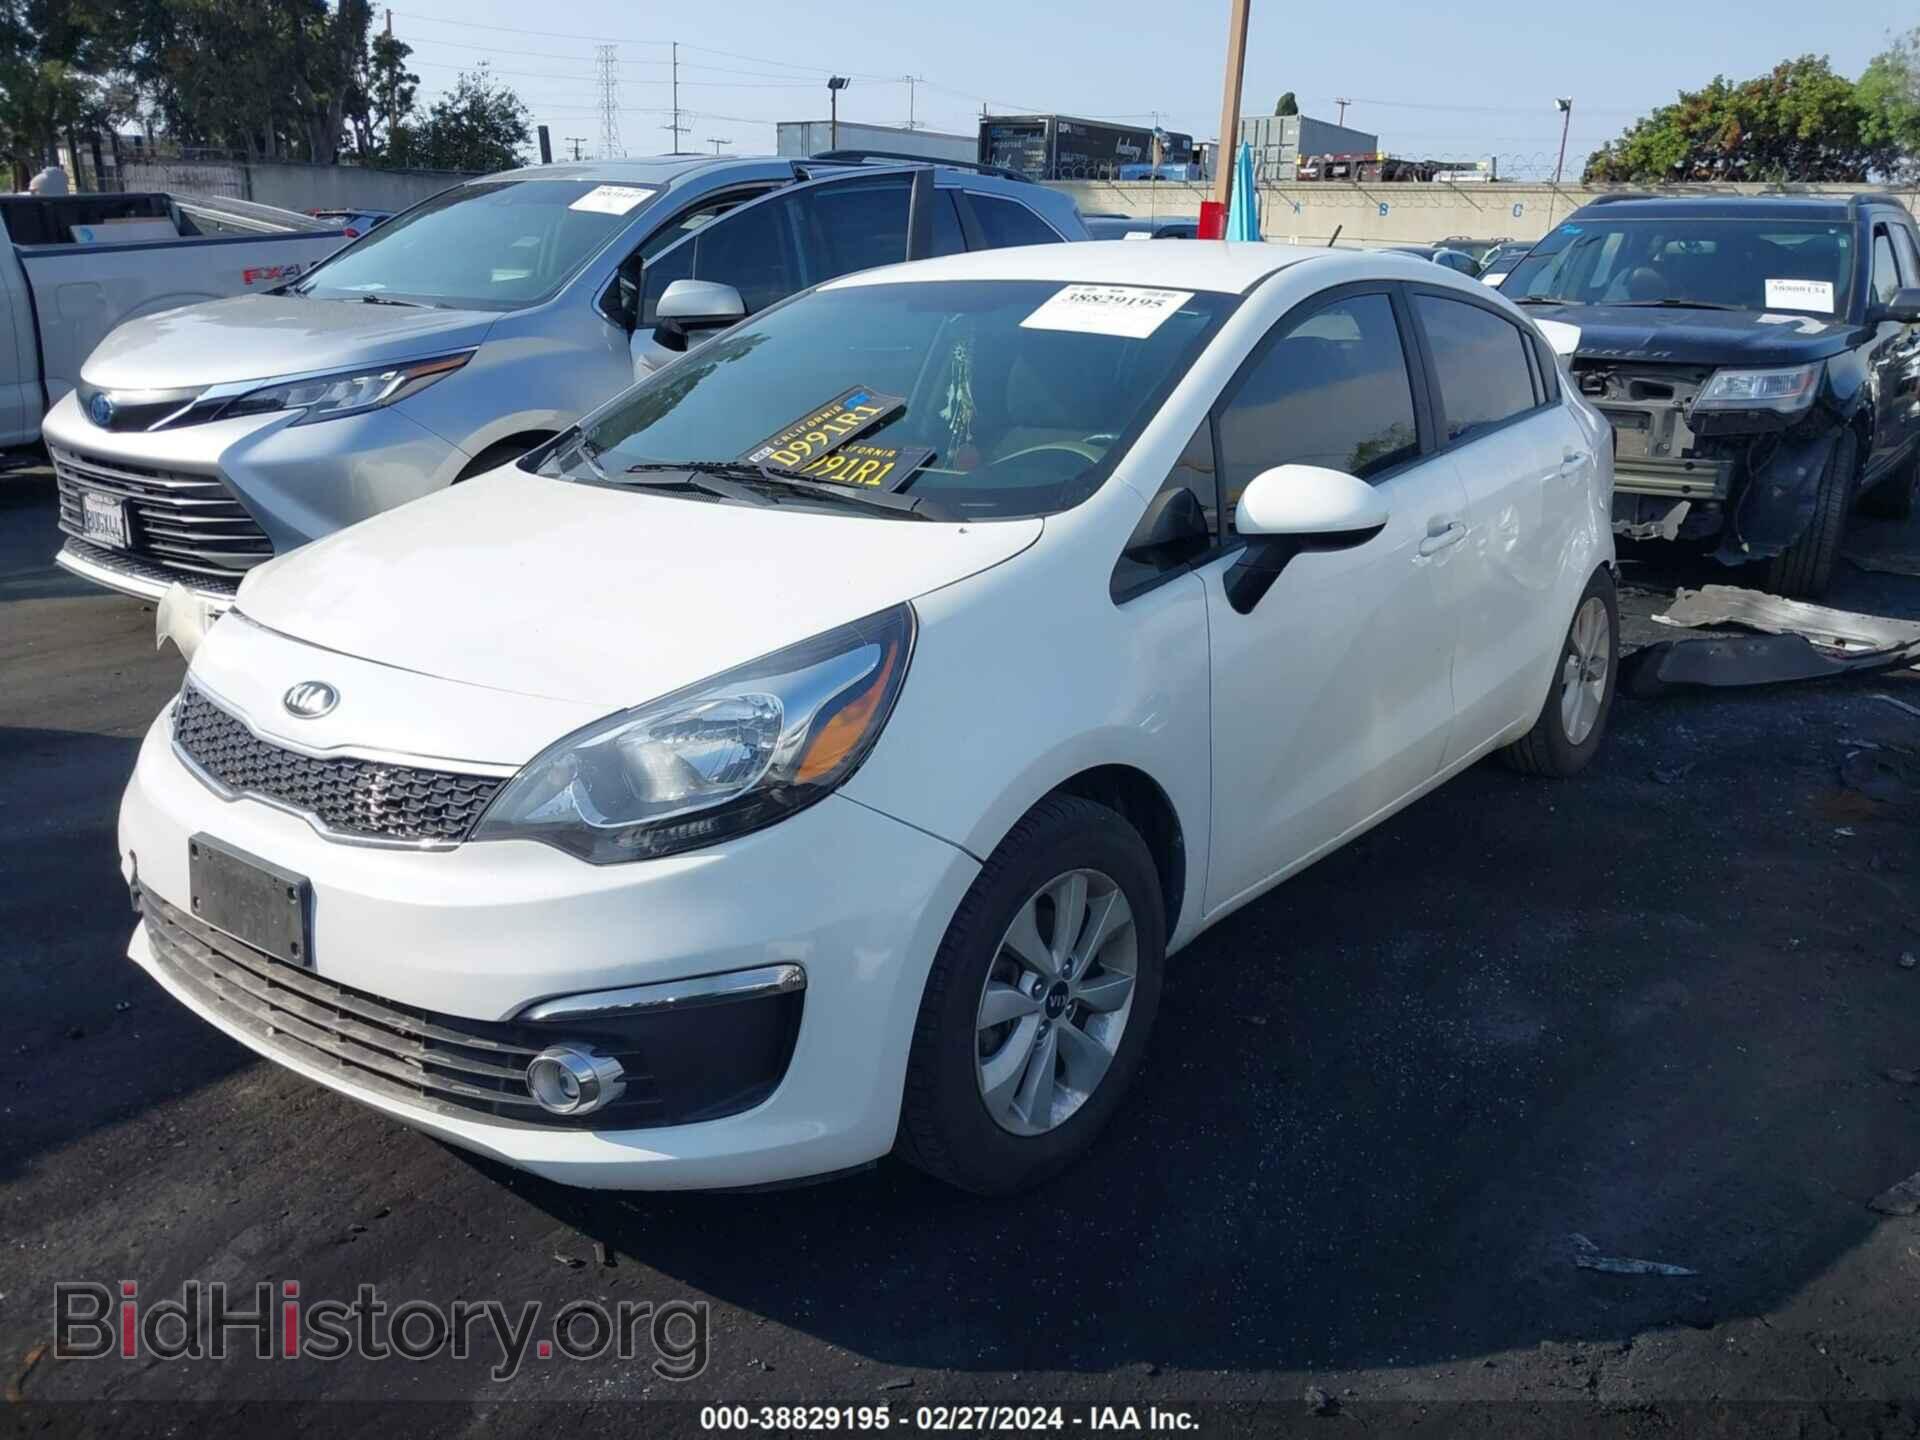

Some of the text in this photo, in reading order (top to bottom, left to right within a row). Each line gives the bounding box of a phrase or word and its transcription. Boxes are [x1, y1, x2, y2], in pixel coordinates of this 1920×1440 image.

[1378, 202, 1389, 217] B
[1512, 203, 1523, 218] C
[769, 405, 885, 468] D991R1
[773, 404, 844, 446] CALIFORNIA
[801, 455, 896, 486] 91R1
